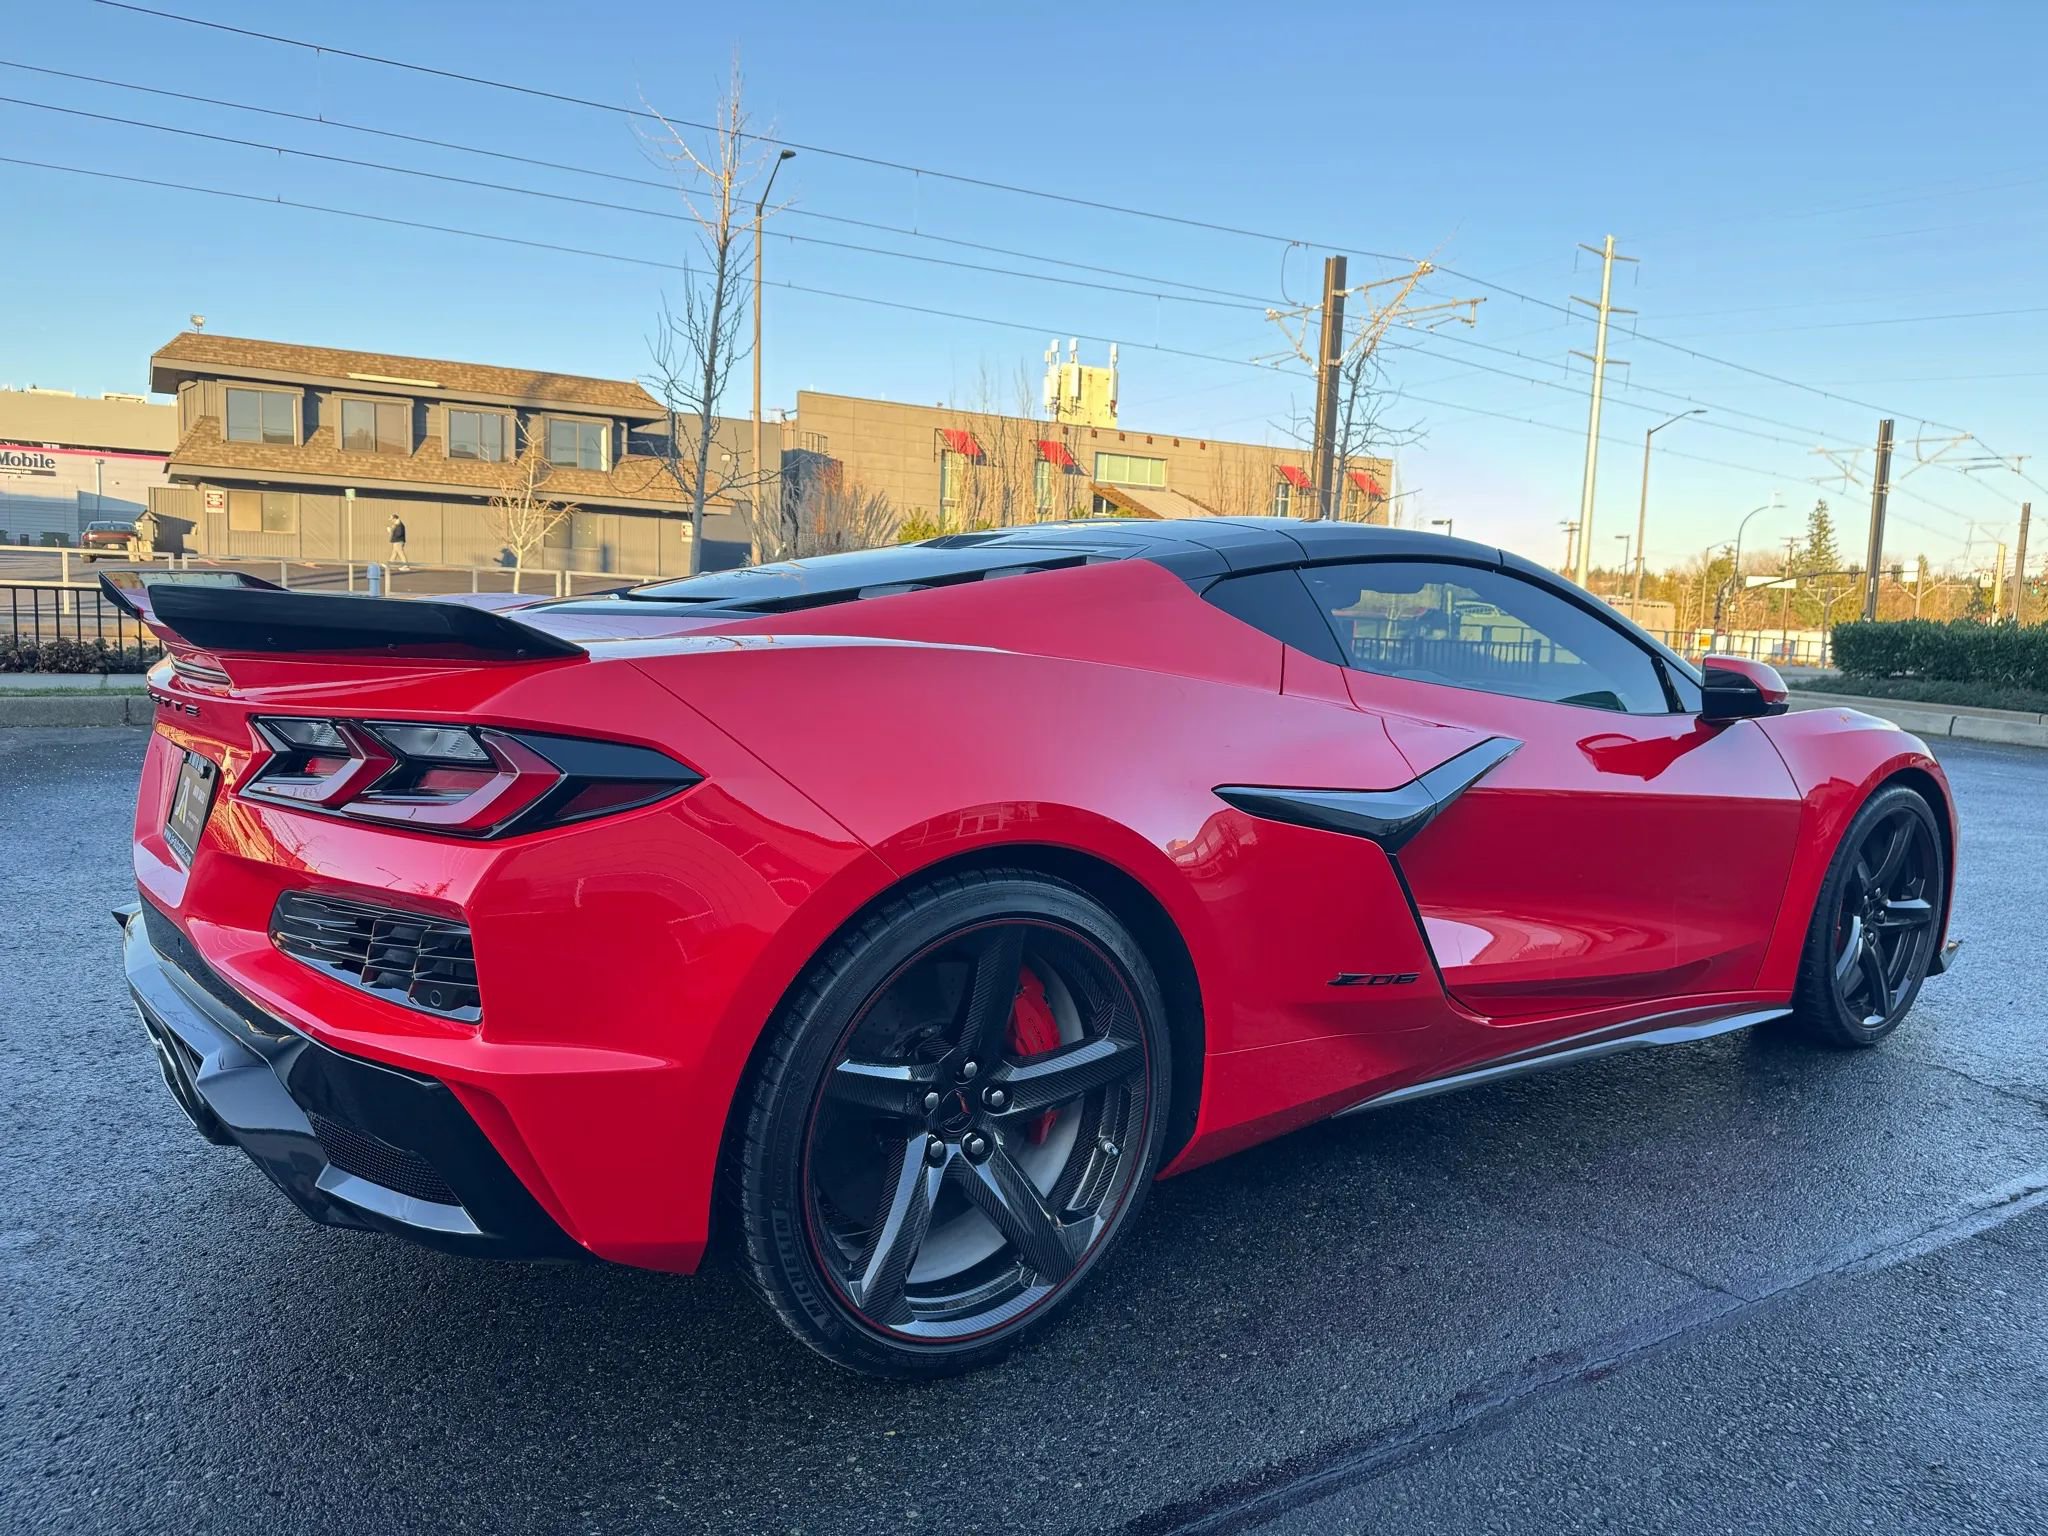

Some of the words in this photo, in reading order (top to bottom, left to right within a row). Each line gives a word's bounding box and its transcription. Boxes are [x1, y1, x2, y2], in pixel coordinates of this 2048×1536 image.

[0, 451, 56, 469] Mobile
[1327, 971, 1421, 986] Z06
[774, 1216, 827, 1318] MICHELIN
